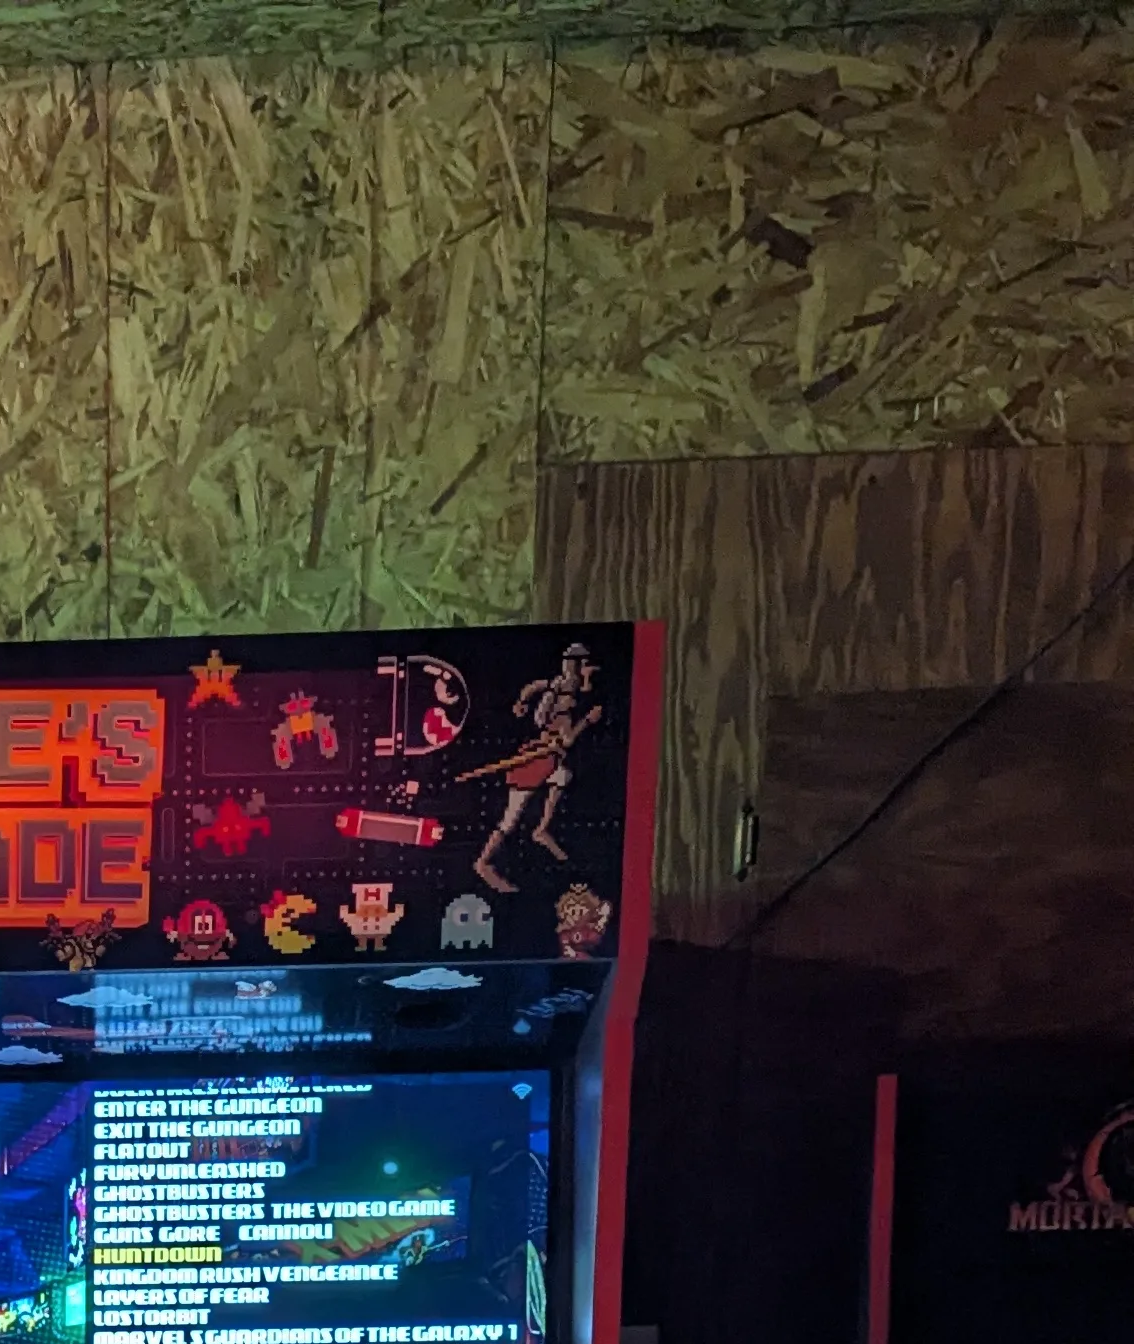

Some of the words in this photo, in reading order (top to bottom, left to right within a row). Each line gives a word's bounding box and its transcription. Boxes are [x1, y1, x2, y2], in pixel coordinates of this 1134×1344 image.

[94, 1101, 166, 1117] ENTER
[169, 1099, 212, 1116] THE
[214, 1097, 322, 1115] GUNGEON
[94, 1123, 145, 1139] EXIT
[147, 1121, 191, 1137] THE
[193, 1119, 301, 1137] GUNGEON
[94, 1143, 191, 1159] FLATOUT
[94, 1164, 156, 1181] FURY
[157, 1162, 286, 1179] UNLEASHED
[94, 1183, 265, 1201] GHOSTBUSTERS
[94, 1204, 265, 1222] GHOSTBUSTERS
[270, 1203, 315, 1219] THE
[316, 1203, 386, 1218] VIDEO
[389, 1200, 455, 1217] GAME
[1007, 1199, 1133, 1232] MORTA
[94, 1227, 153, 1243] GUNS
[158, 1226, 221, 1242] GORE
[238, 1224, 333, 1241] CANNOLI
[94, 1247, 222, 1264] HUNTDOWN
[94, 1268, 198, 1285] KINGDOM
[200, 1267, 261, 1283] RUSH
[263, 1264, 399, 1282] VENGEANCE
[94, 1289, 177, 1306] LAYERS
[178, 1288, 209, 1304] OF
[210, 1287, 270, 1304] FEAR
[205, 1328, 333, 1344] GUARDIANS
[334, 1327, 365, 1344] OF
[367, 1326, 410, 1342] THE
[412, 1325, 503, 1342] GALAXY
